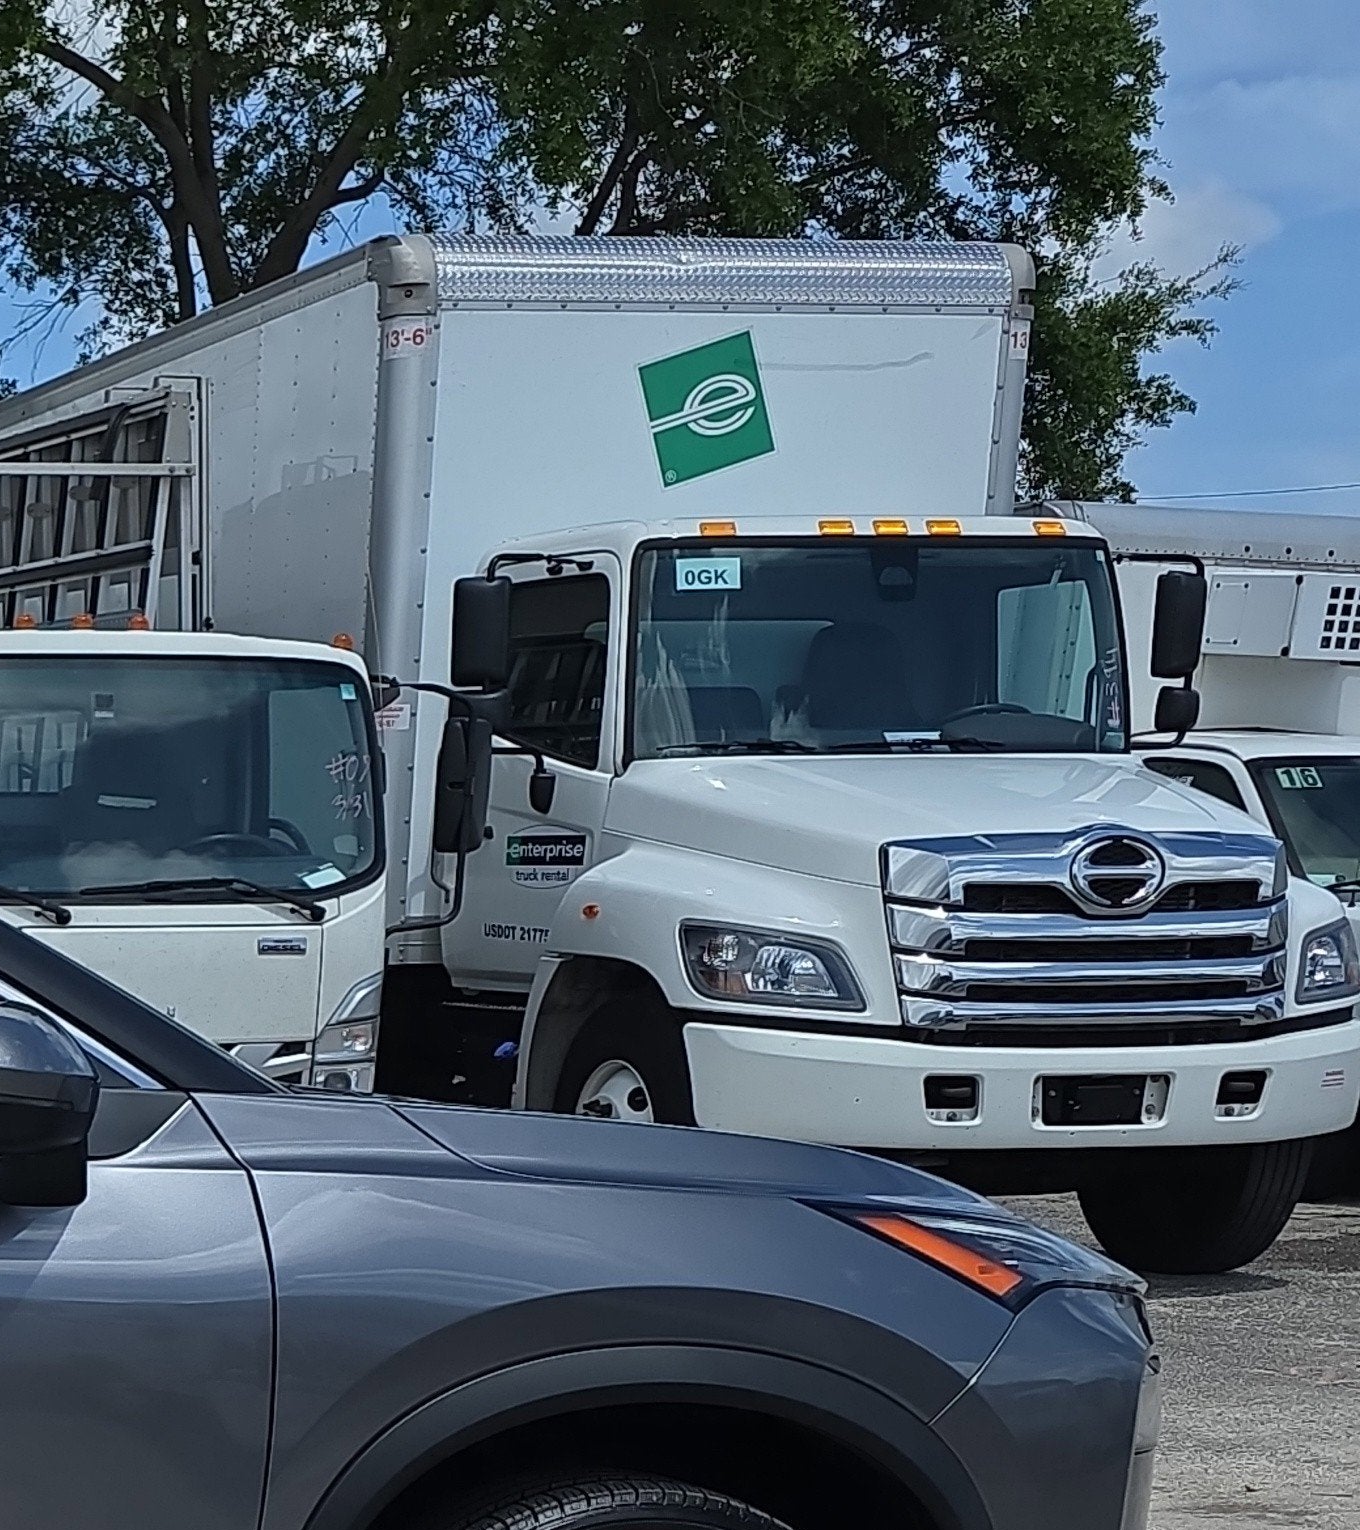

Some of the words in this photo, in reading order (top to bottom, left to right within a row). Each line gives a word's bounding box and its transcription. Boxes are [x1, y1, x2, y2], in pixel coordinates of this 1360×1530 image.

[1280, 768, 1319, 787] 16
[509, 840, 584, 862] enterprise
[515, 867, 539, 881] truck
[541, 867, 570, 881] rental
[484, 922, 517, 940] USDOT
